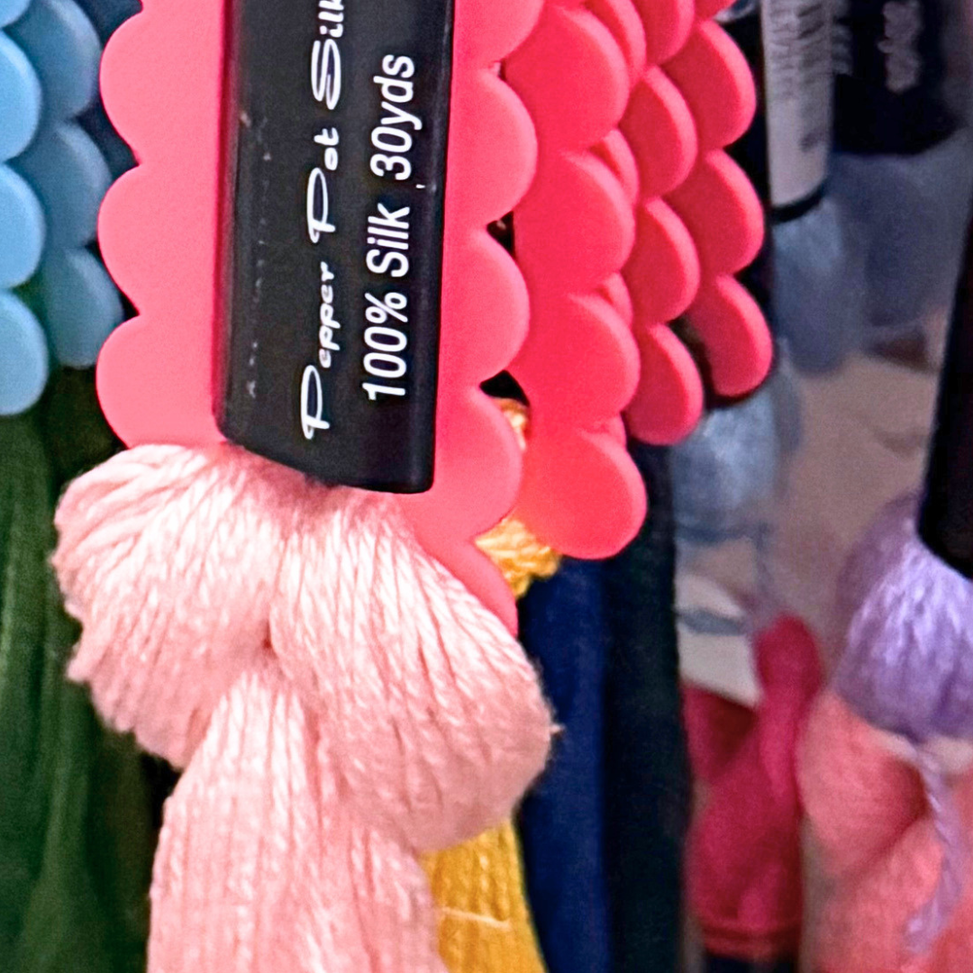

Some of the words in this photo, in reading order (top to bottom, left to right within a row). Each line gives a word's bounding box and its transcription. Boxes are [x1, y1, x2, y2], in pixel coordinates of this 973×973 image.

[370, 54, 423, 180] 30yds
[306, 127, 341, 244] Pot
[366, 202, 410, 277] Silk
[300, 261, 341, 439] Pepper
[362, 291, 408, 401] 100%
